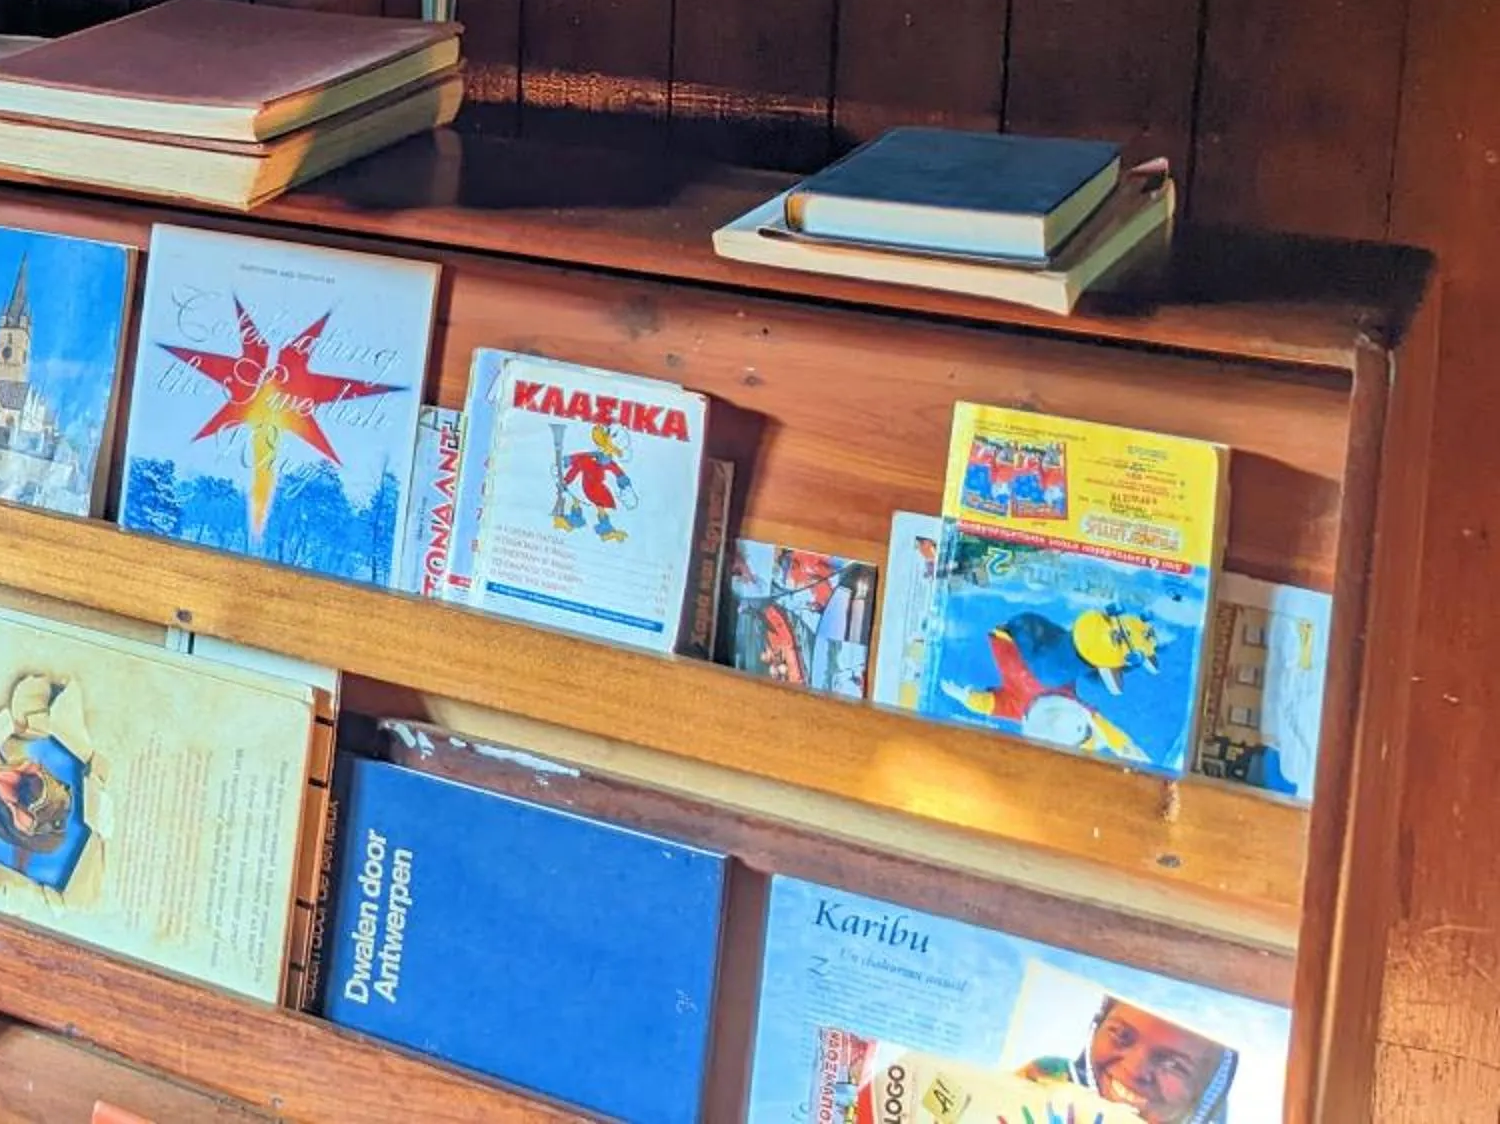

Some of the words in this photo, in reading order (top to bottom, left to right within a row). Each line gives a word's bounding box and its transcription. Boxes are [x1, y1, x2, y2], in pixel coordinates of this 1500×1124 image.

[358, 828, 388, 899] door
[344, 901, 380, 1005] Dwalen
[373, 848, 413, 1004] Antwerpen
[814, 898, 933, 954] Karibu
